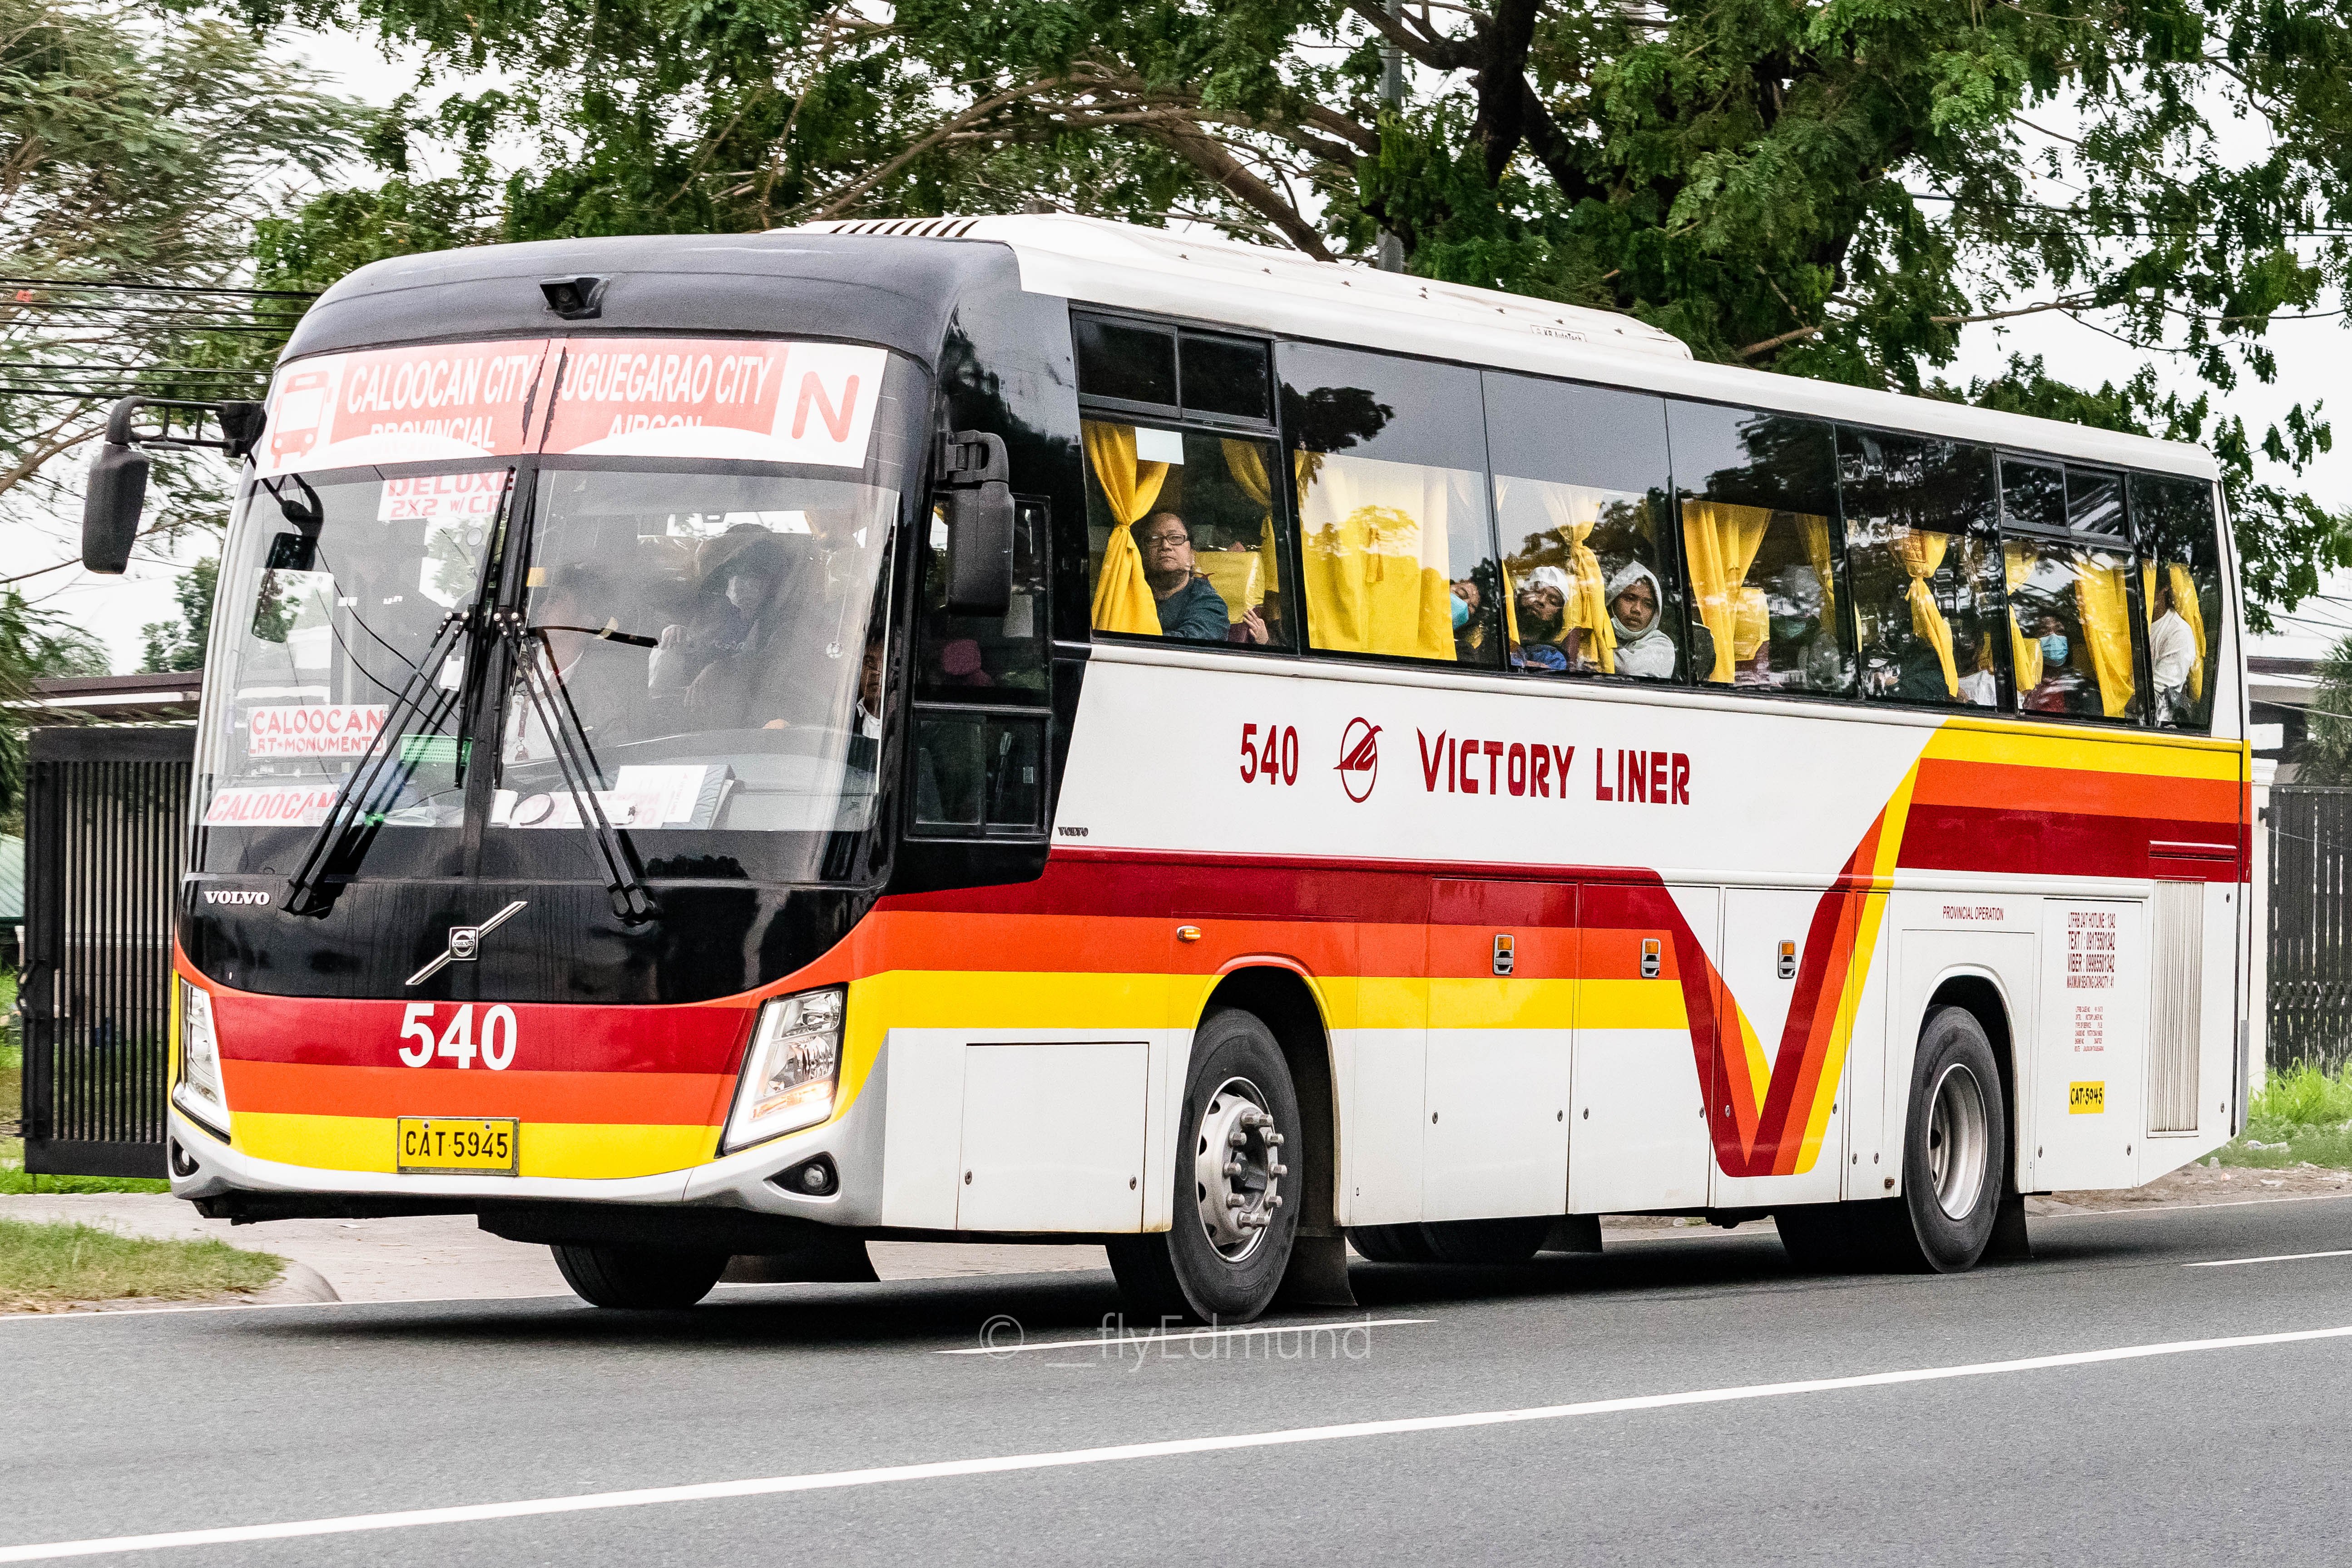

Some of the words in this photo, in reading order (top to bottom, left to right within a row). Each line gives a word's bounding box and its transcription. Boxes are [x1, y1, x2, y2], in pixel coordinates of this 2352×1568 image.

[347, 357, 483, 414] CALOOCAN
[484, 355, 539, 405] CITY
[715, 355, 775, 405] CITY
[792, 371, 859, 443] N
[390, 498, 438, 518] 2X2
[252, 708, 385, 735] CALOOCAN
[1240, 722, 1299, 786] 540
[1595, 747, 1690, 805] LINER
[208, 791, 337, 821] CALOOCAN
[1058, 826, 1089, 837] VOLVO
[204, 890, 271, 905] VOLVO
[1943, 905, 1974, 920] PROVINCIAL
[1975, 906, 2004, 921] OPERATION
[2068, 912, 2080, 928] LTFRB
[2089, 912, 2105, 929] HOTLINE
[2108, 912, 2116, 929] 1342
[2068, 930, 2080, 950] TEXT
[2086, 931, 2115, 950] 09175501342
[2067, 953, 2082, 972] VIBER
[2086, 954, 2115, 973] 09985501342
[2081, 975, 2094, 989] SEATING
[2094, 975, 2109, 989] CAPACITY
[398, 1003, 517, 1071] 540
